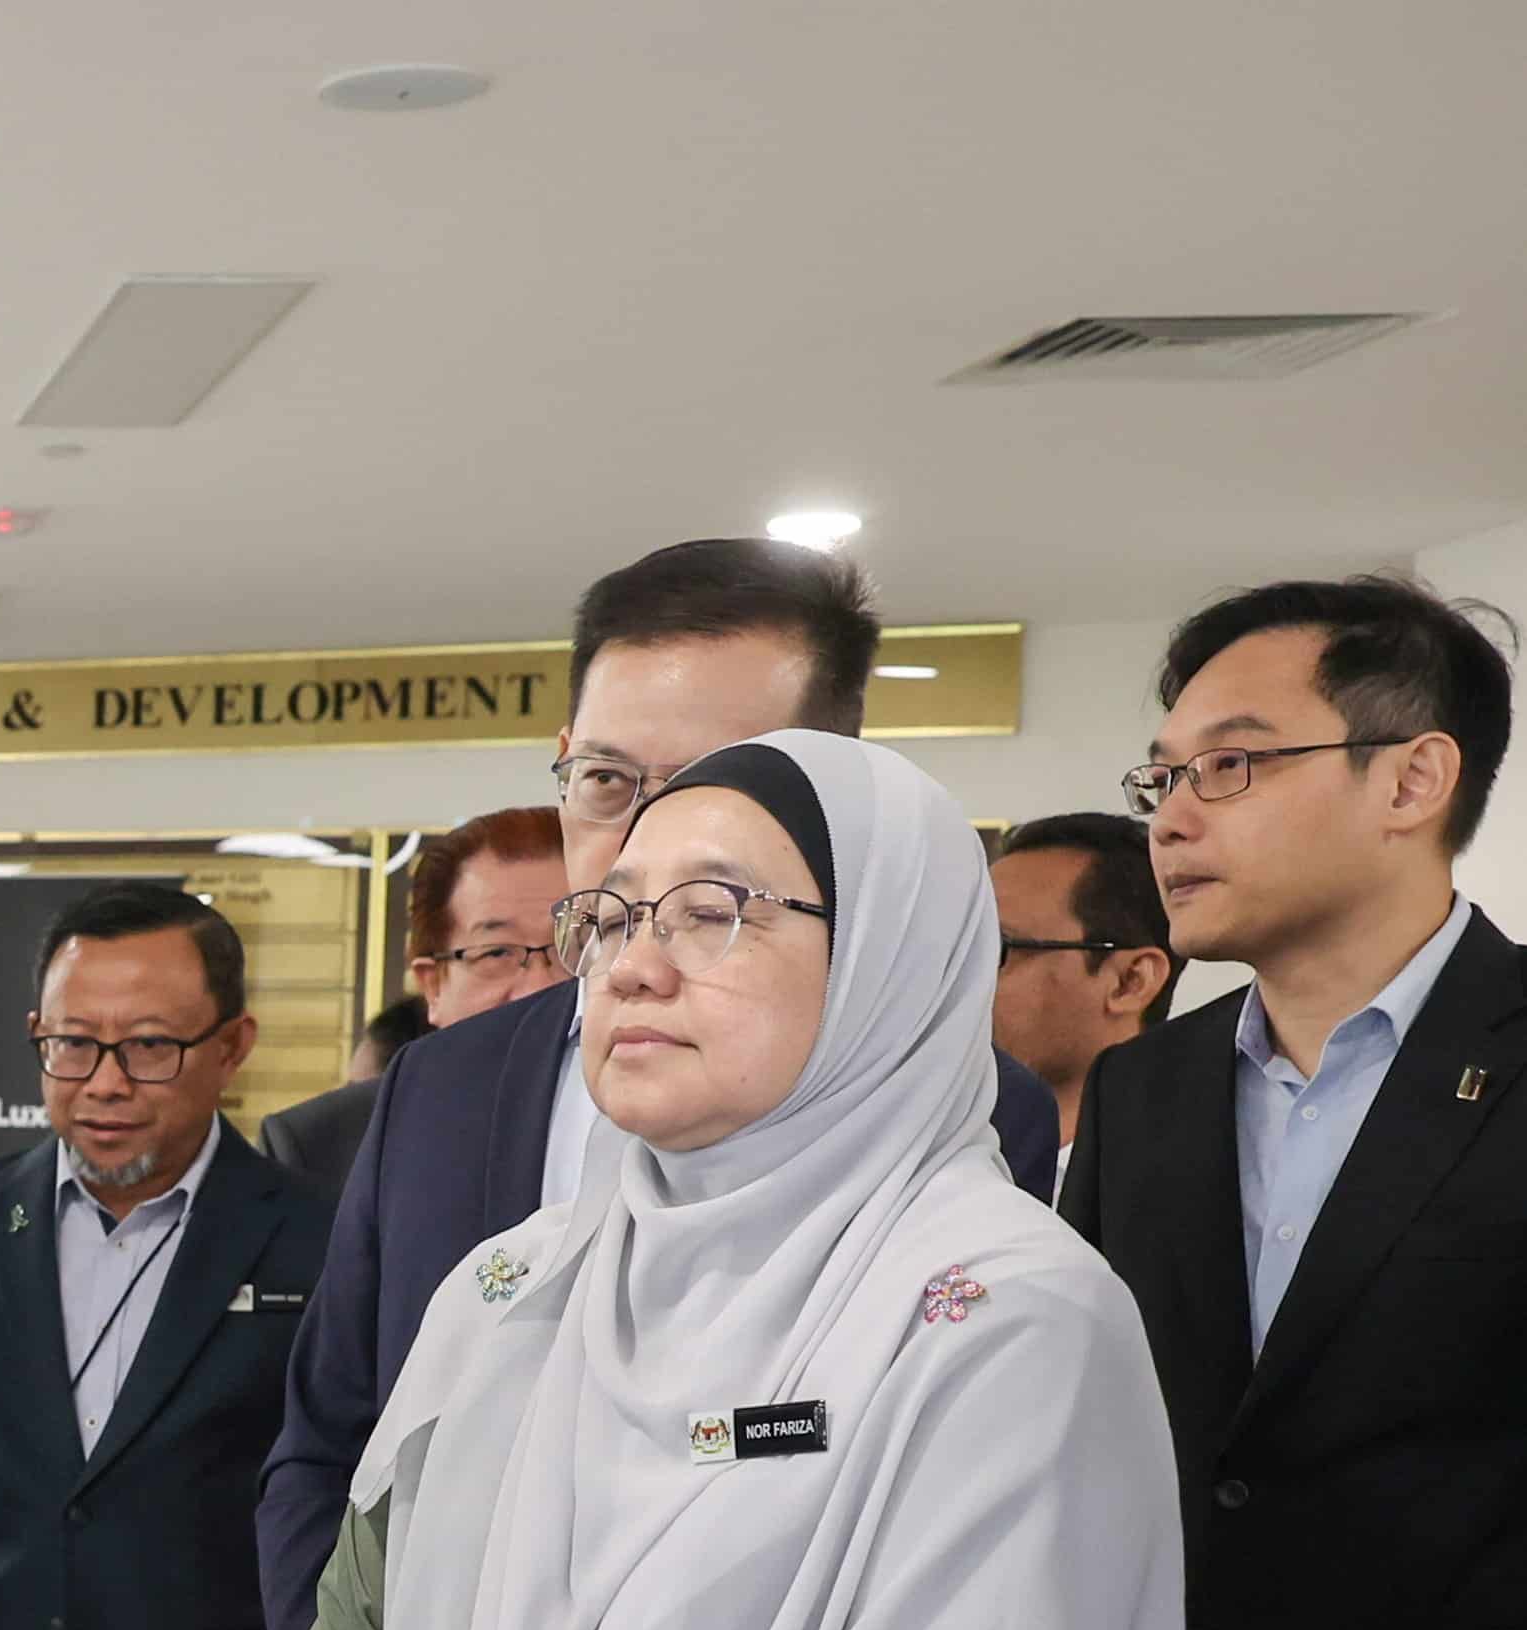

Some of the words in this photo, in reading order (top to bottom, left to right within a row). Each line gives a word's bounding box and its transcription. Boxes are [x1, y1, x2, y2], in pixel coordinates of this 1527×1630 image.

[2, 689, 44, 731] &
[93, 673, 545, 729] DEVELOPMENT
[746, 1422, 772, 1440] NOR
[773, 1419, 815, 1437] FARIZA
